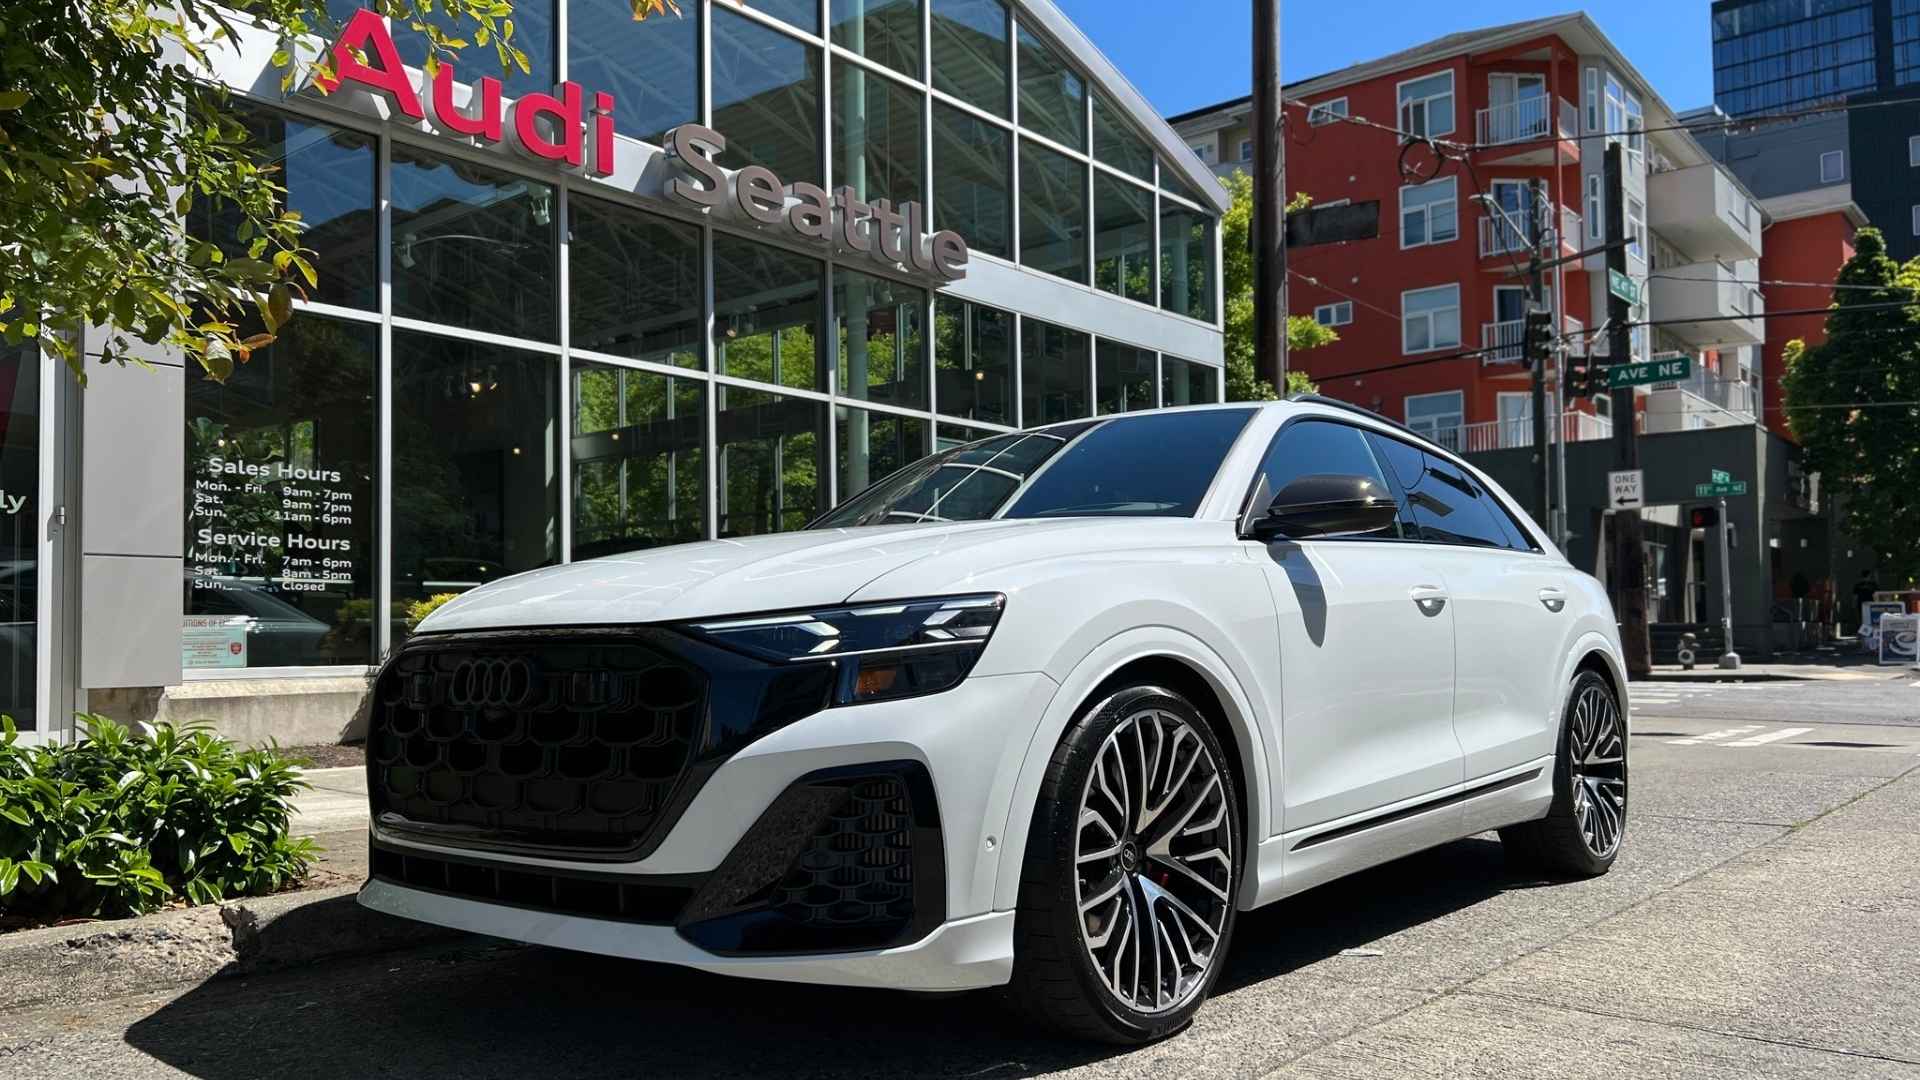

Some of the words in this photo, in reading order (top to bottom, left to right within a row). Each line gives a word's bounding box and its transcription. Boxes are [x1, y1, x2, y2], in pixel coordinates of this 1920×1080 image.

[320, 8, 614, 176] Audi
[664, 124, 968, 284] Seattle
[1618, 367, 1648, 381] AVE
[1659, 362, 1683, 377] NE
[208, 457, 270, 476] Sales
[277, 463, 341, 482] Hours
[1615, 474, 1637, 484] ONE
[195, 479, 231, 492] Mon.
[244, 483, 266, 494] Fri.
[282, 486, 312, 498] 9am
[323, 489, 352, 501] 7pm
[1615, 484, 1638, 495] WAY
[195, 492, 224, 505] Sat.
[282, 499, 312, 510] 9am
[322, 502, 352, 513] 7pm
[195, 506, 227, 518] Sun.
[274, 511, 312, 522] 11am
[322, 514, 352, 525] 6pm
[197, 528, 281, 547] Service
[287, 533, 351, 551] Hours
[195, 552, 231, 564] Mon.
[244, 554, 266, 565] Fri.
[281, 556, 312, 566] 7am
[322, 557, 352, 569] 6pm
[194, 565, 223, 576] Sat.
[281, 568, 312, 579] 8am
[322, 570, 352, 581] 5pm
[281, 582, 325, 591] Closed
